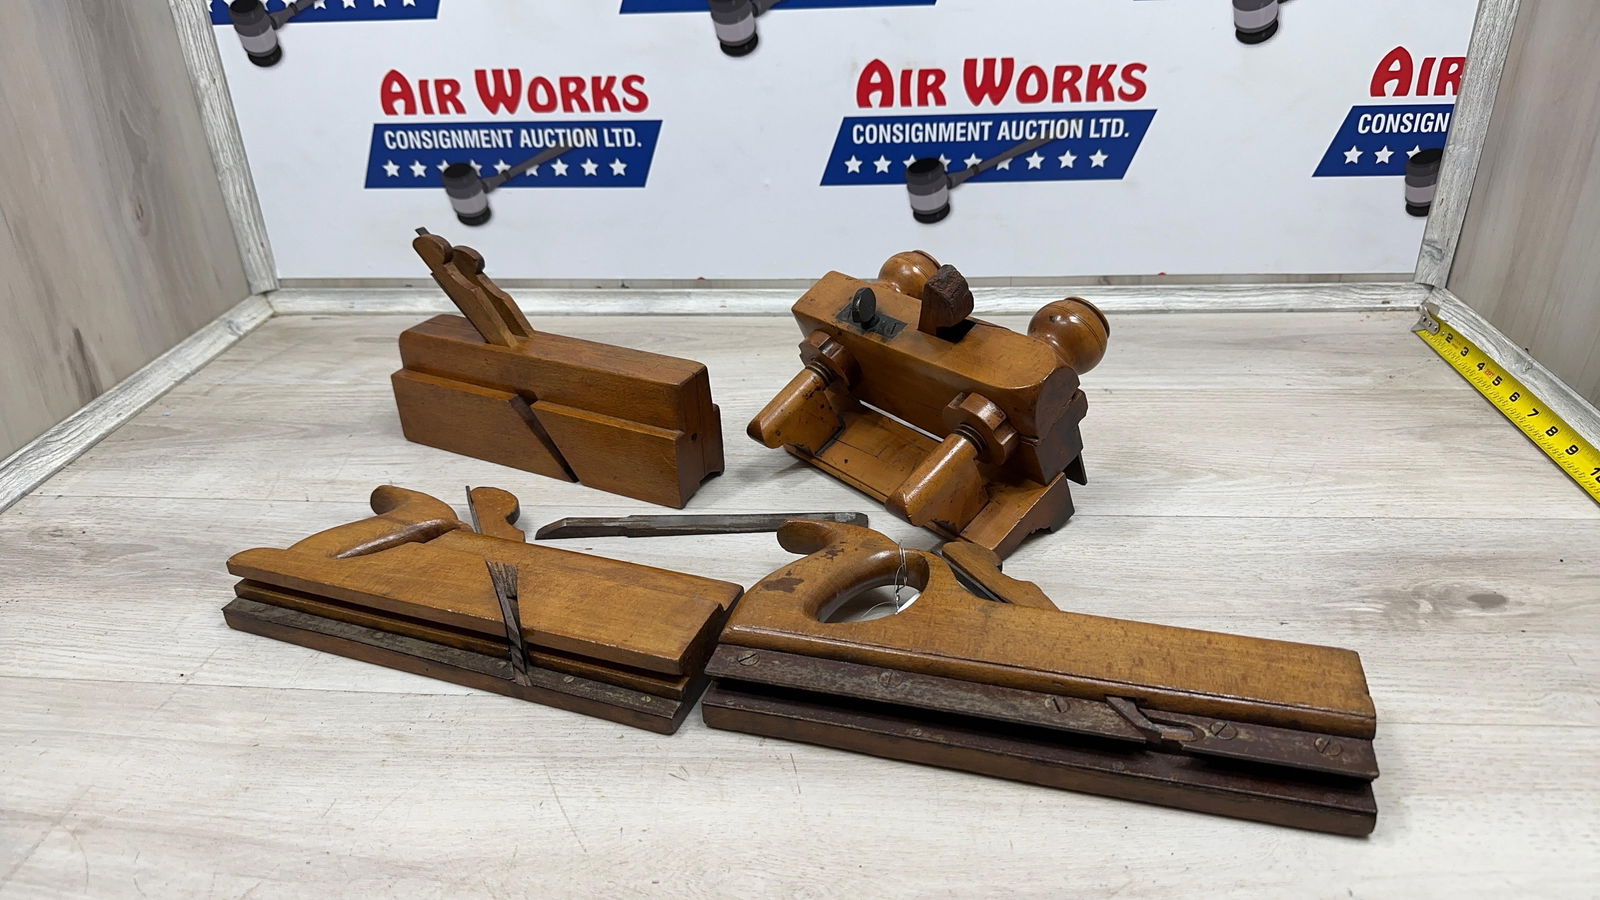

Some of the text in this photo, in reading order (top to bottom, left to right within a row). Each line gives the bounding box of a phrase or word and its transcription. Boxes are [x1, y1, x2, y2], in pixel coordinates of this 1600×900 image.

[380, 68, 649, 115] AIR WORKS
[856, 57, 1148, 108] AIR WORKS
[384, 128, 642, 150] CONSIGNMENT AUCTION LTD.
[852, 118, 1130, 144] CONSIGNMENT AUCTION LTD.
[1358, 112, 1450, 135] CONSIGN
[1445, 333, 1453, 343] 2
[1460, 346, 1469, 357] 3
[1476, 362, 1486, 371] 4
[1491, 376, 1502, 386] 5
[1509, 391, 1520, 402] 6
[1527, 408, 1539, 417] 7
[1545, 426, 1559, 436] 8
[1565, 444, 1579, 455] 9
